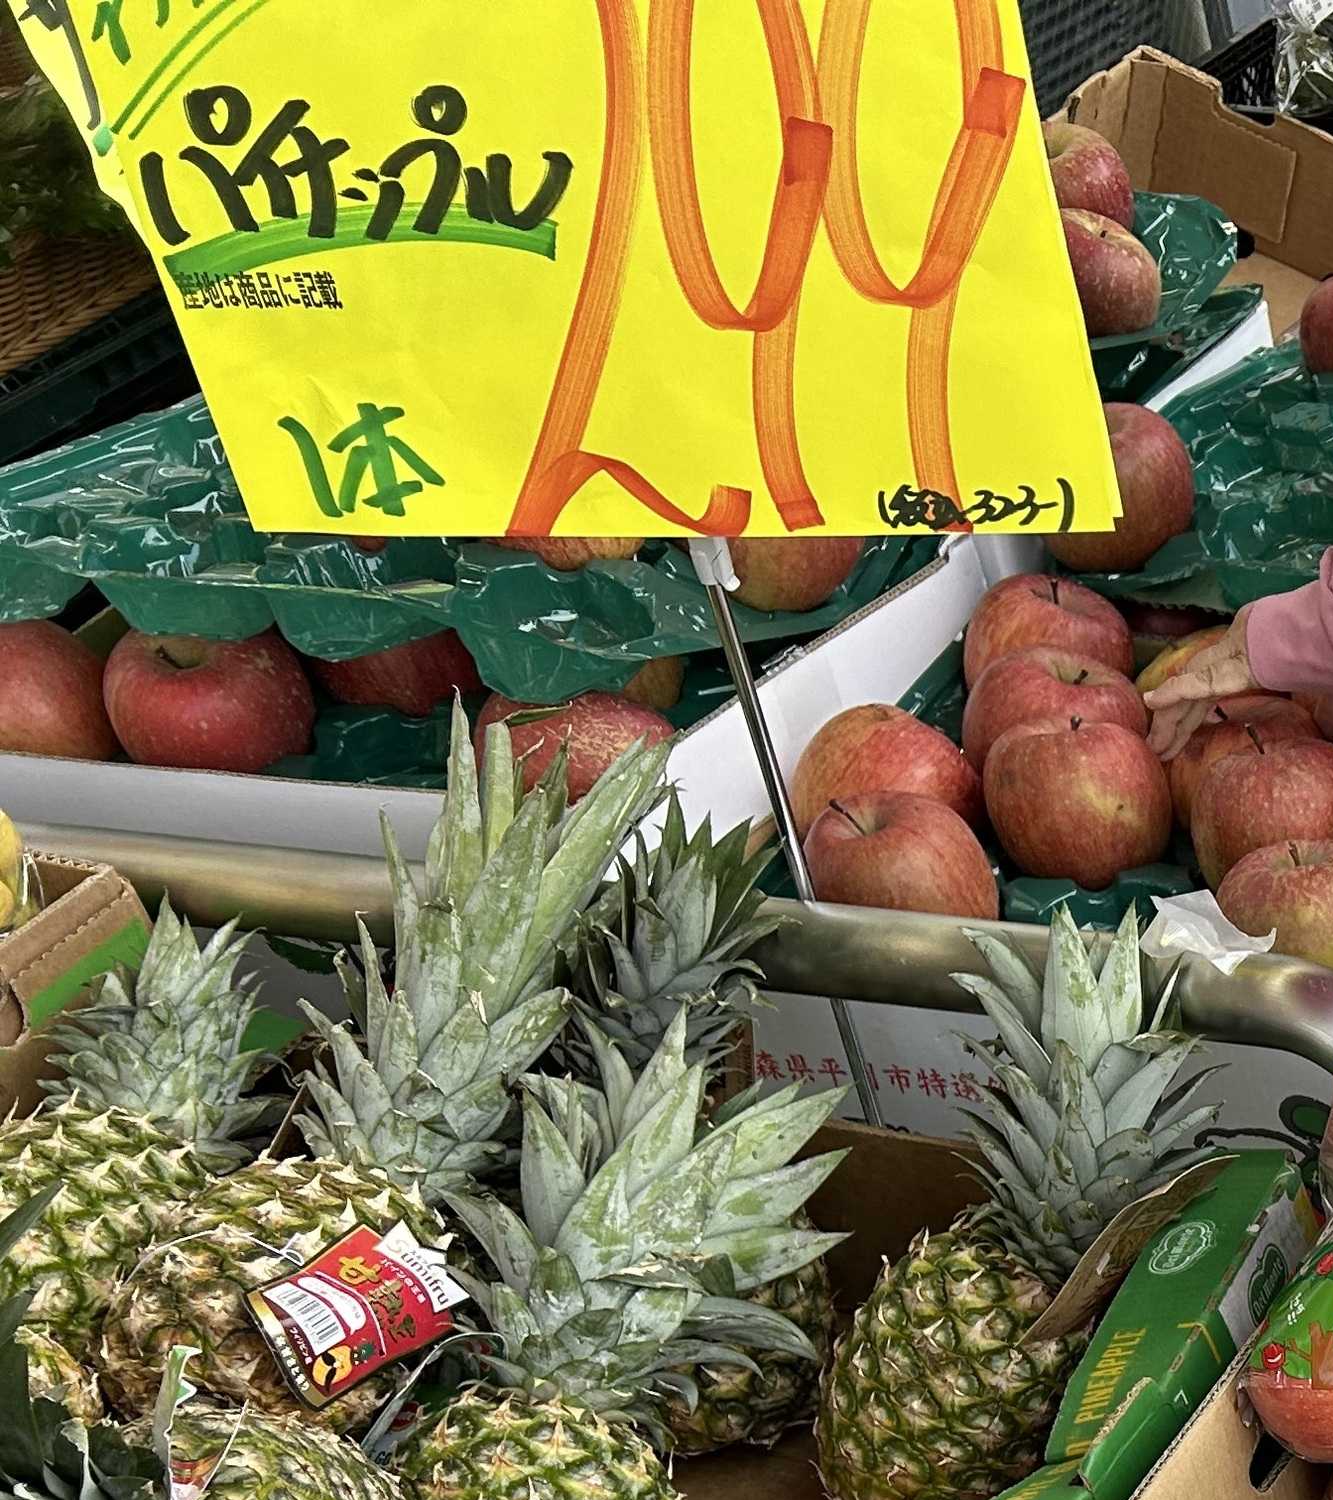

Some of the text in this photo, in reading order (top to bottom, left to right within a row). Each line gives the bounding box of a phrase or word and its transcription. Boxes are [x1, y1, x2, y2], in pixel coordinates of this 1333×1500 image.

[177, 271, 344, 311] 産地は商品に記載
